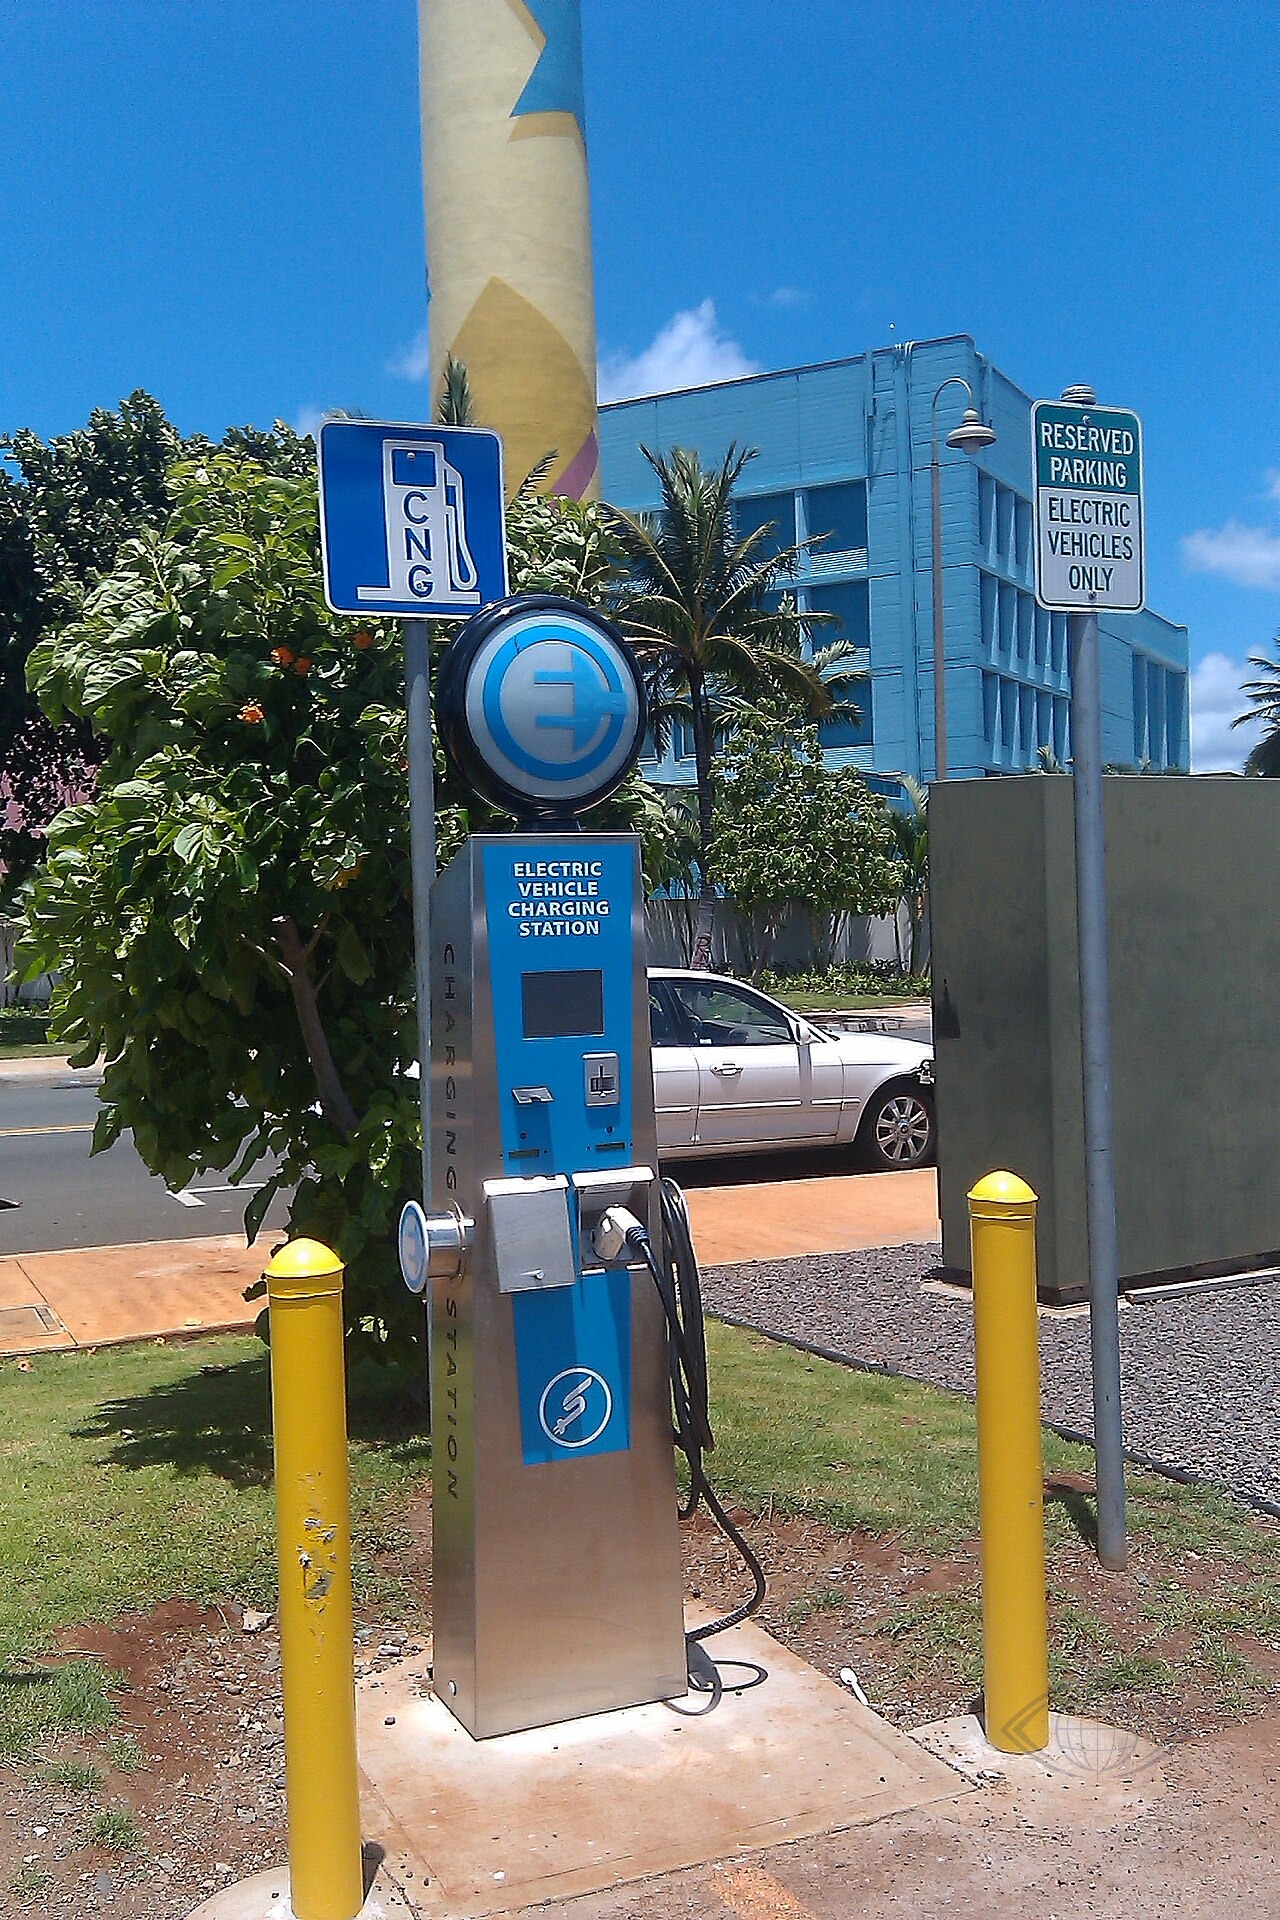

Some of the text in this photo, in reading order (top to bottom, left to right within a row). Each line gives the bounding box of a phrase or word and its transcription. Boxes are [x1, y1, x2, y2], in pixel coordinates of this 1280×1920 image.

[1041, 422, 1134, 455] RESERVED
[1050, 456, 1127, 488] PARKING
[1048, 496, 1131, 528] ELECTRIC
[403, 491, 434, 598] CNG
[1047, 530, 1133, 560] VEHICLES
[1068, 565, 1114, 592] ONLY
[513, 862, 602, 877] ELECTRIC
[517, 881, 599, 897] VEHICLE
[508, 901, 609, 917] CHARGING
[519, 920, 600, 936] STATION
[443, 943, 458, 1499] CHARGING STATION
